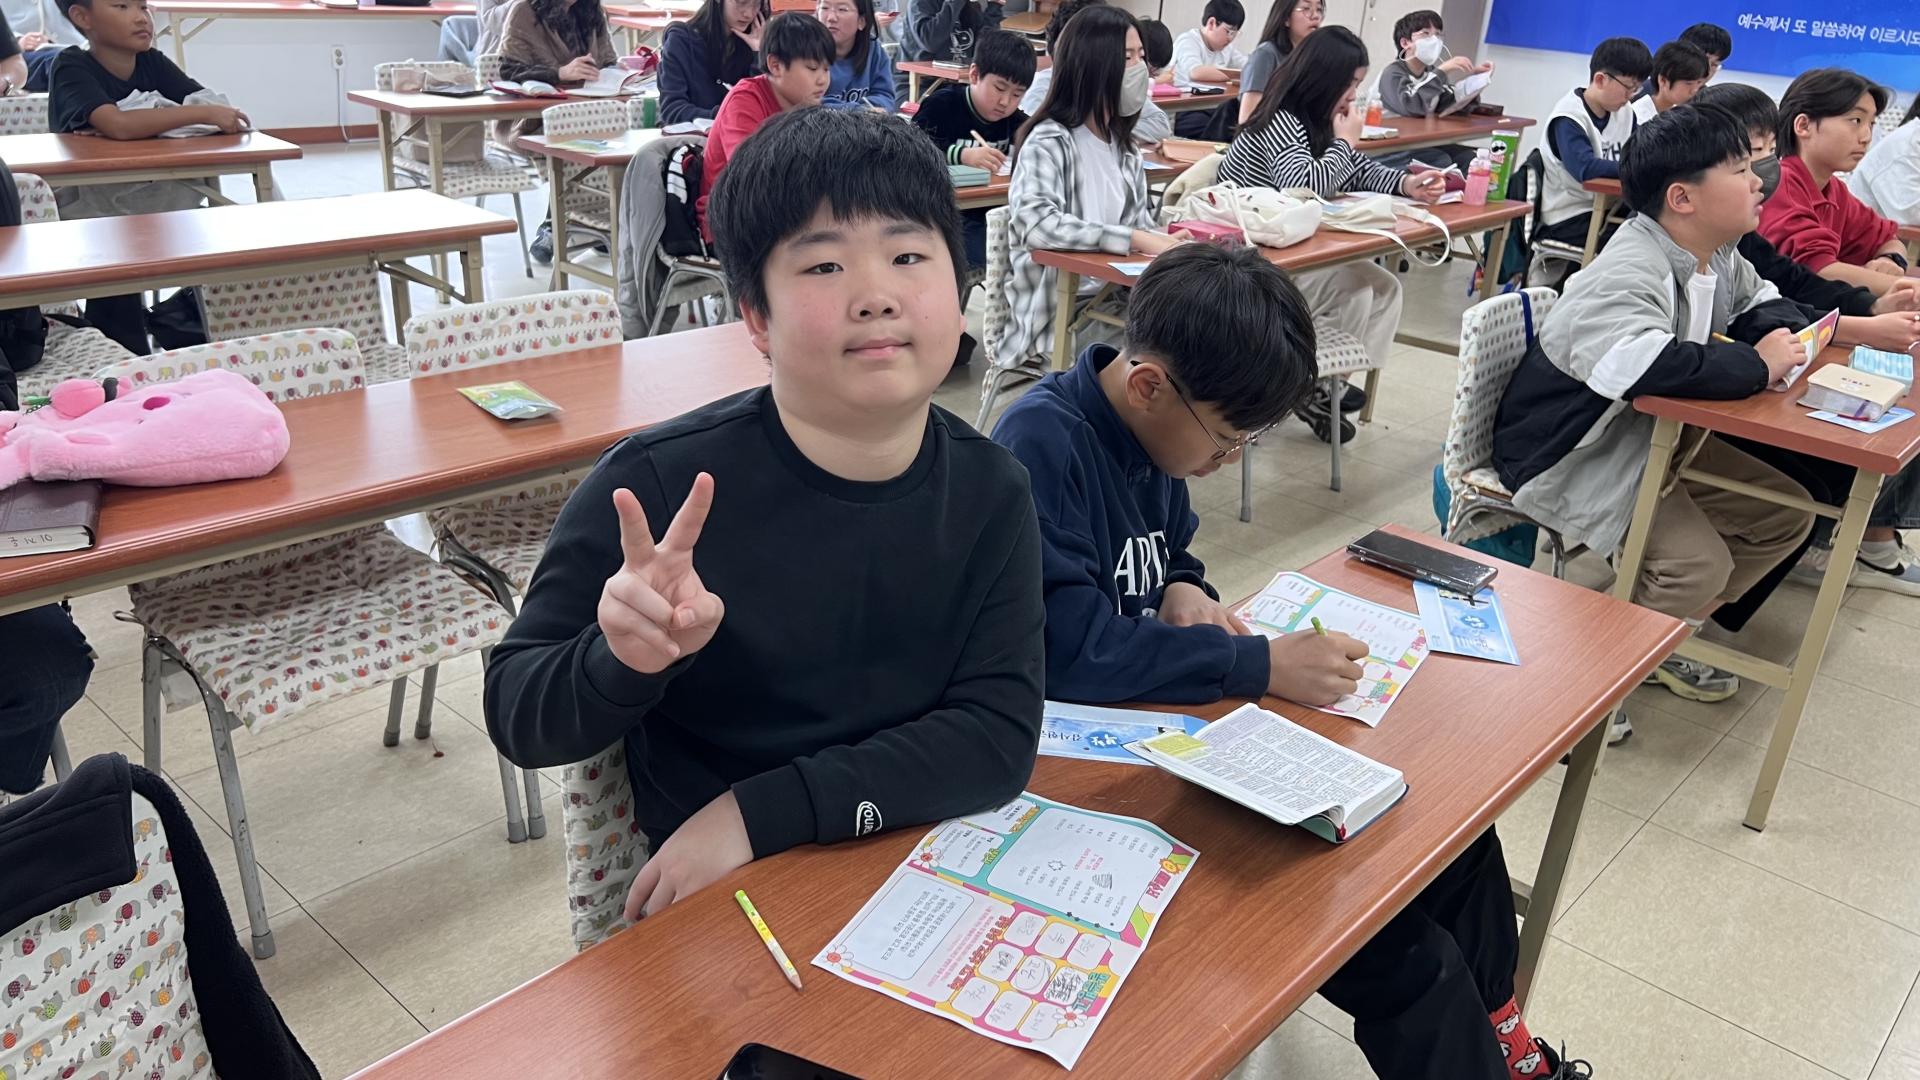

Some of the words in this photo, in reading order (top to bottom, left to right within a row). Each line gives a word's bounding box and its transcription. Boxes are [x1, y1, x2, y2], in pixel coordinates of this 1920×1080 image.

[1738, 13, 1790, 32] 예수께서
[1792, 19, 1807, 33] 또
[1811, 20, 1867, 41] 말씀하여
